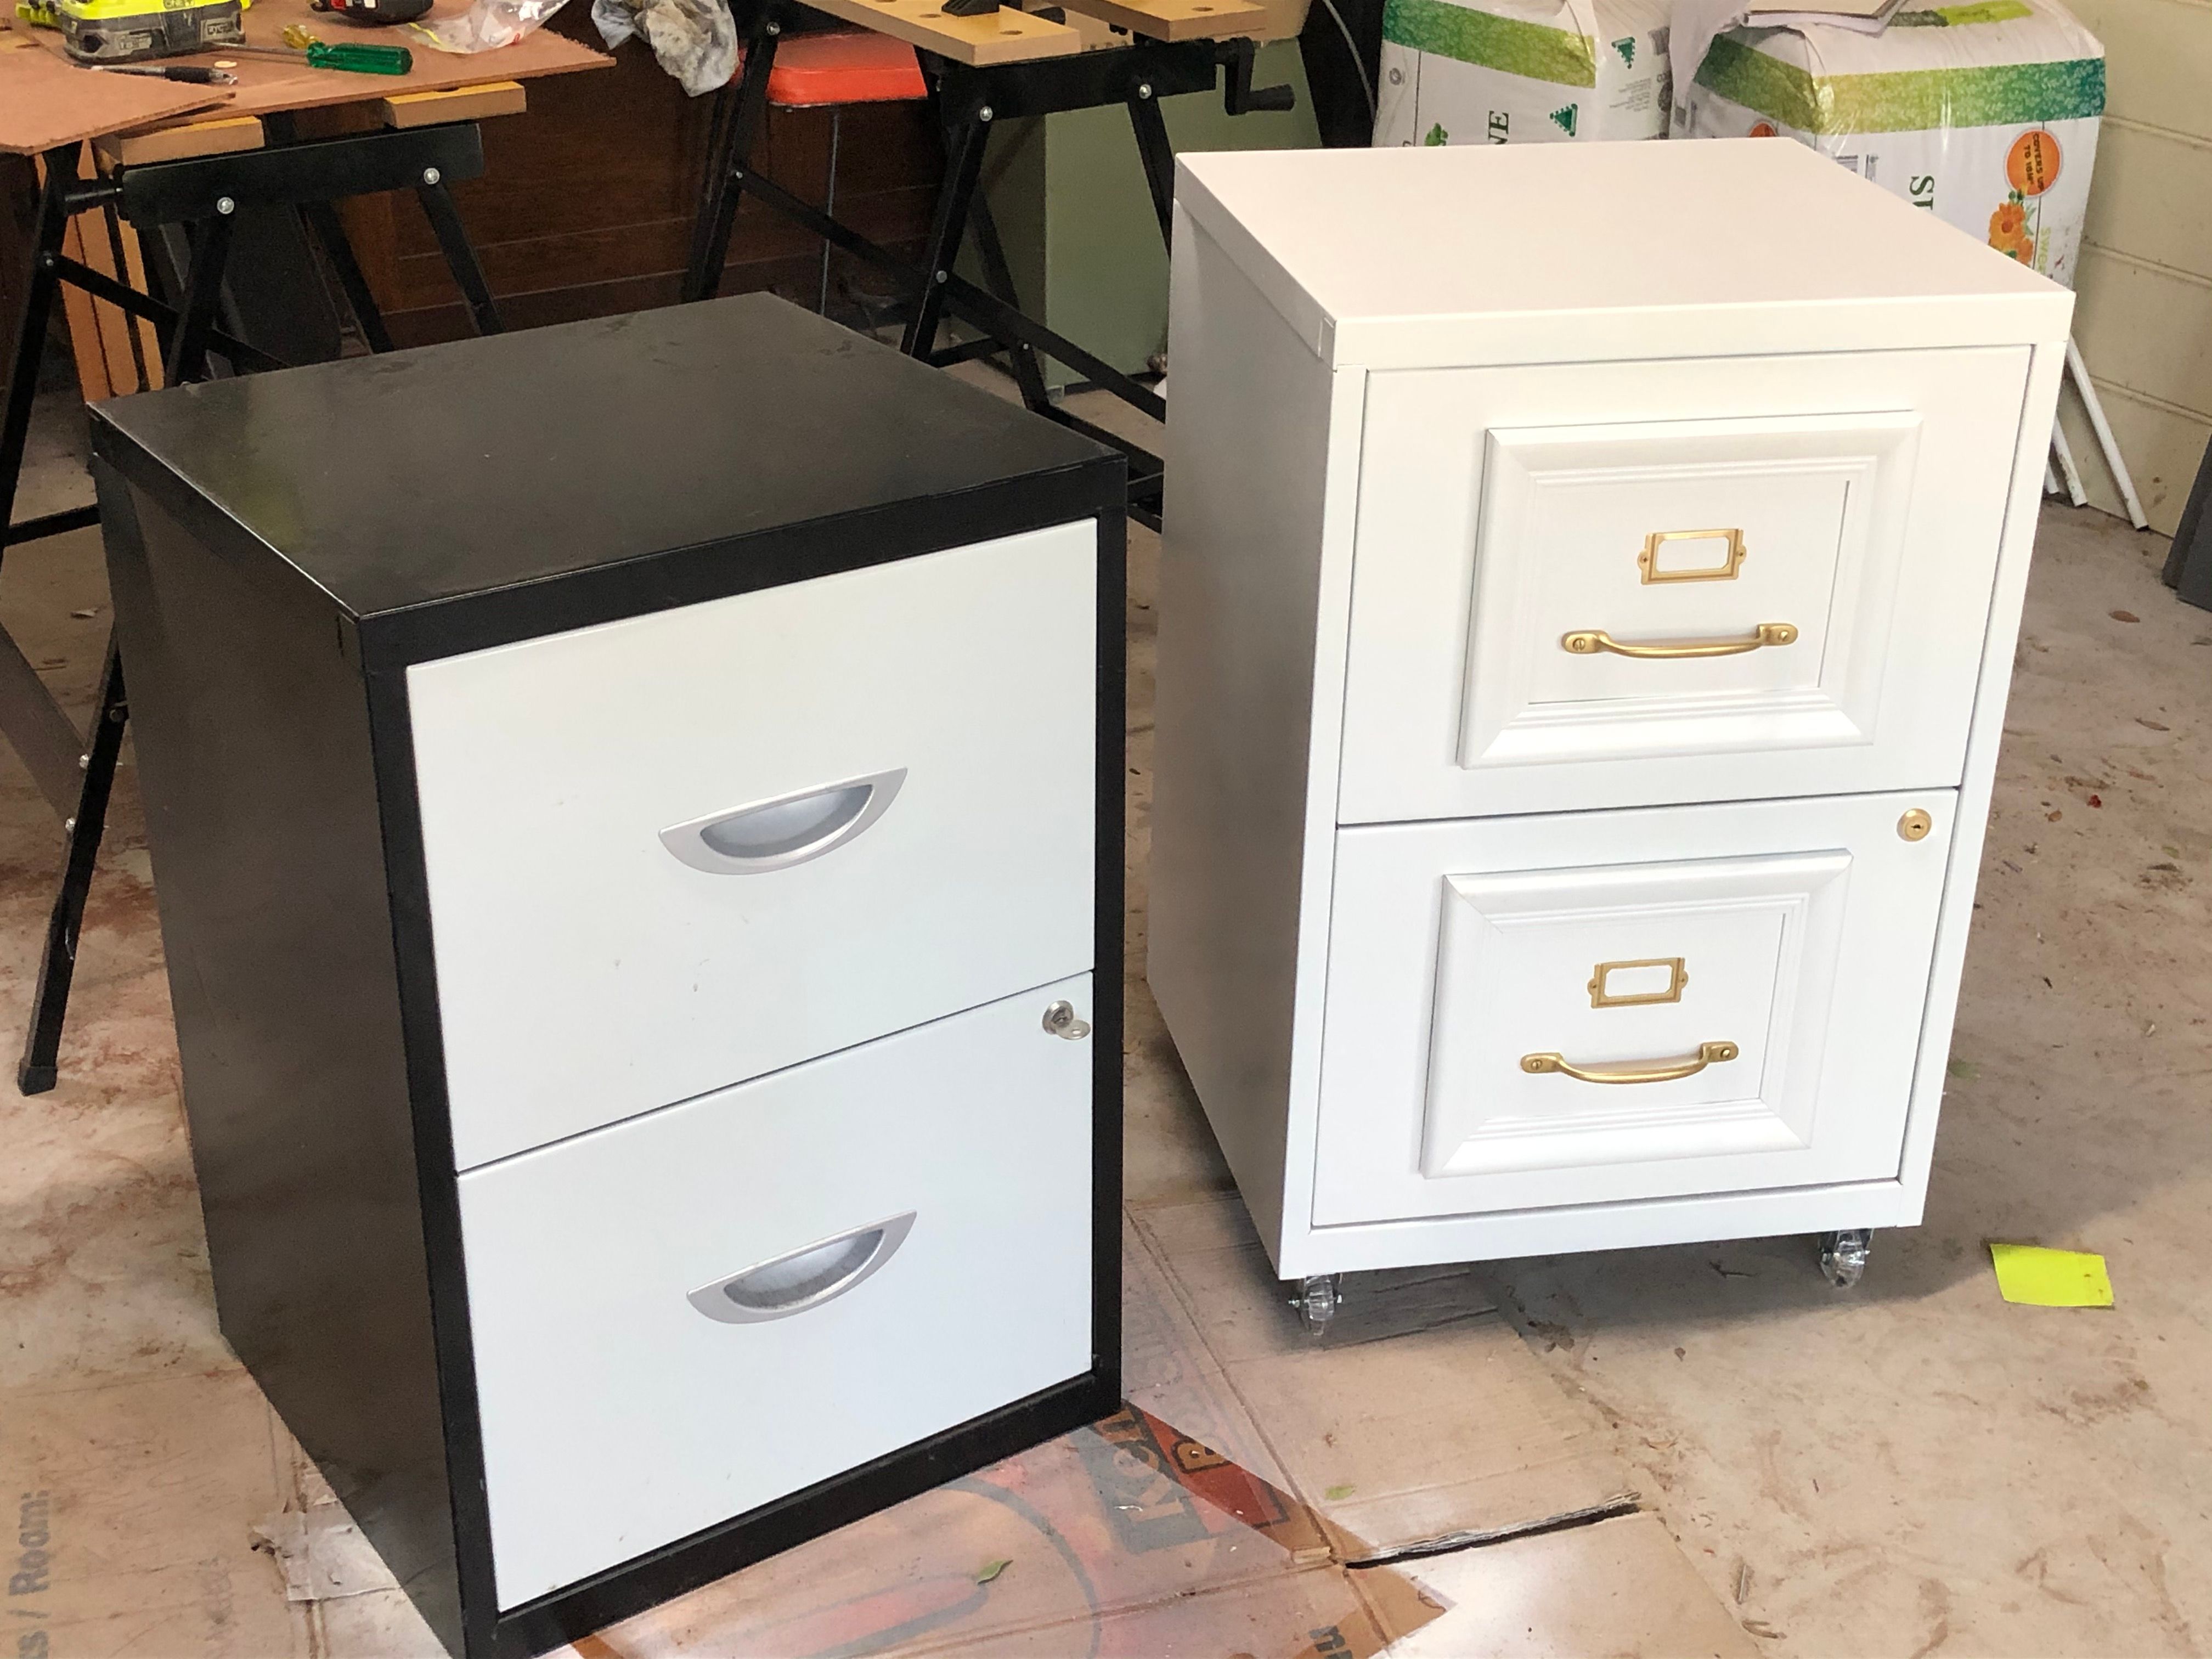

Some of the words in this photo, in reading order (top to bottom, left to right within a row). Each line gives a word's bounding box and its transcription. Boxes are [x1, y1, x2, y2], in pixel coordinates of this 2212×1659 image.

[2024, 144, 2031, 159] TO
[2033, 133, 2043, 174] COVERS
[2037, 176, 2045, 191] UP
